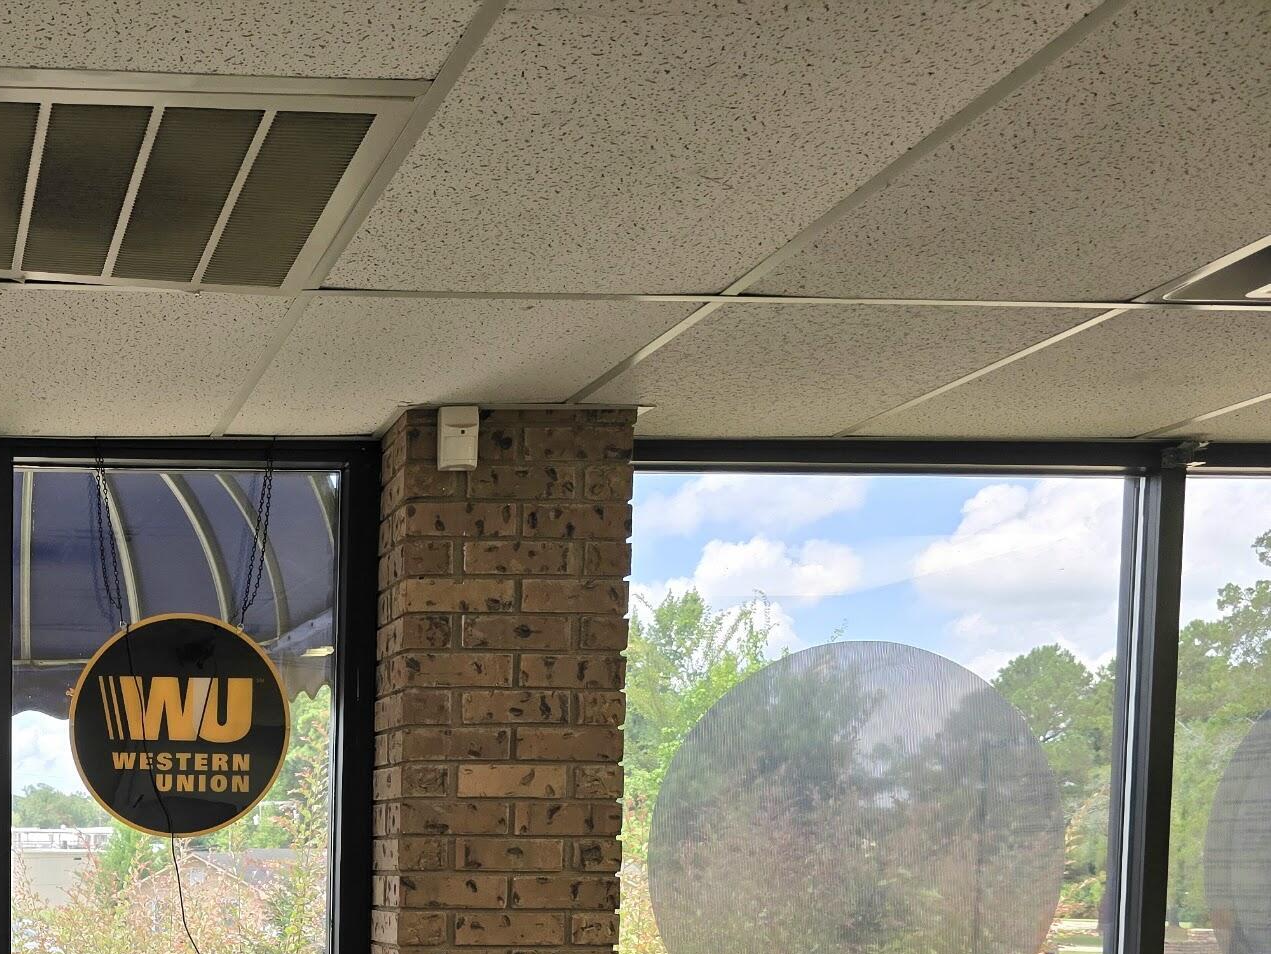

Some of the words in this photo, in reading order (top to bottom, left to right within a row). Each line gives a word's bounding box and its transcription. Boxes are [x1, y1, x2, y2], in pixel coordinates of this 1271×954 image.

[118, 675, 254, 743] WU
[112, 751, 251, 772] WESTERN
[155, 773, 250, 793] UNION
